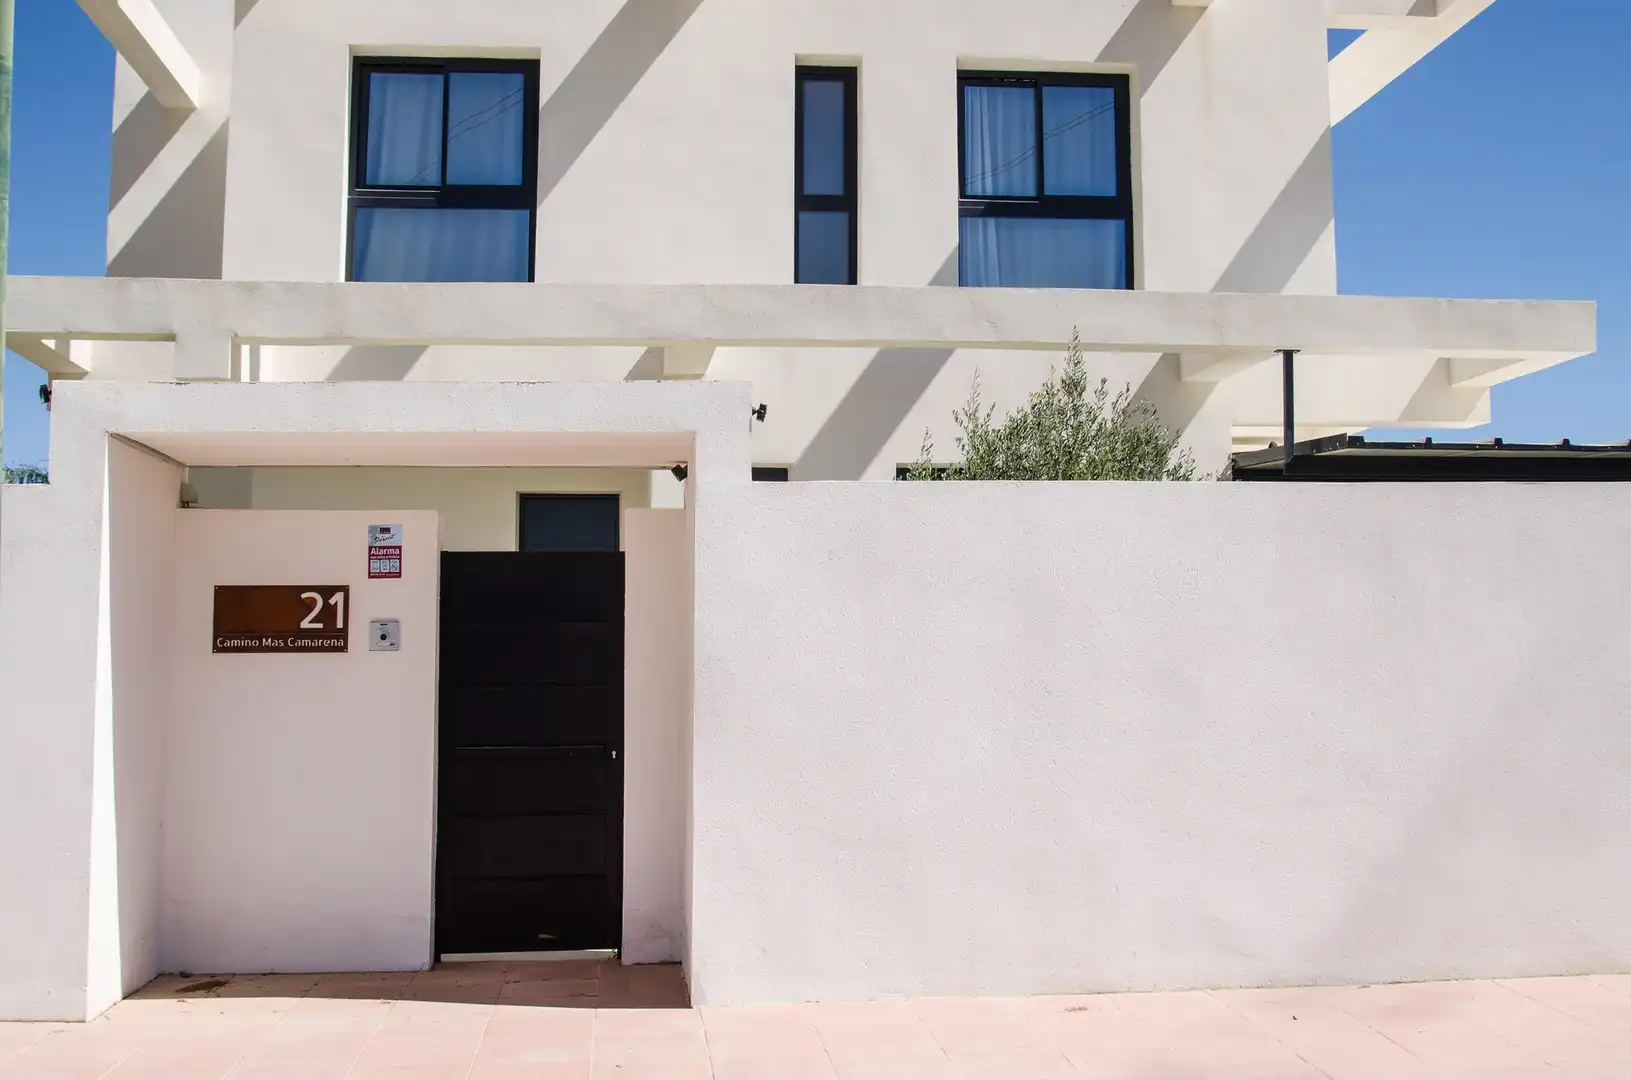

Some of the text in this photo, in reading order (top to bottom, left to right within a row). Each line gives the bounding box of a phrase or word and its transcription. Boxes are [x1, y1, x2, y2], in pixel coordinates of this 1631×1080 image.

[370, 547, 400, 555] Alarma
[300, 591, 345, 629] 21
[216, 637, 344, 648] Camino Mas Camarena
